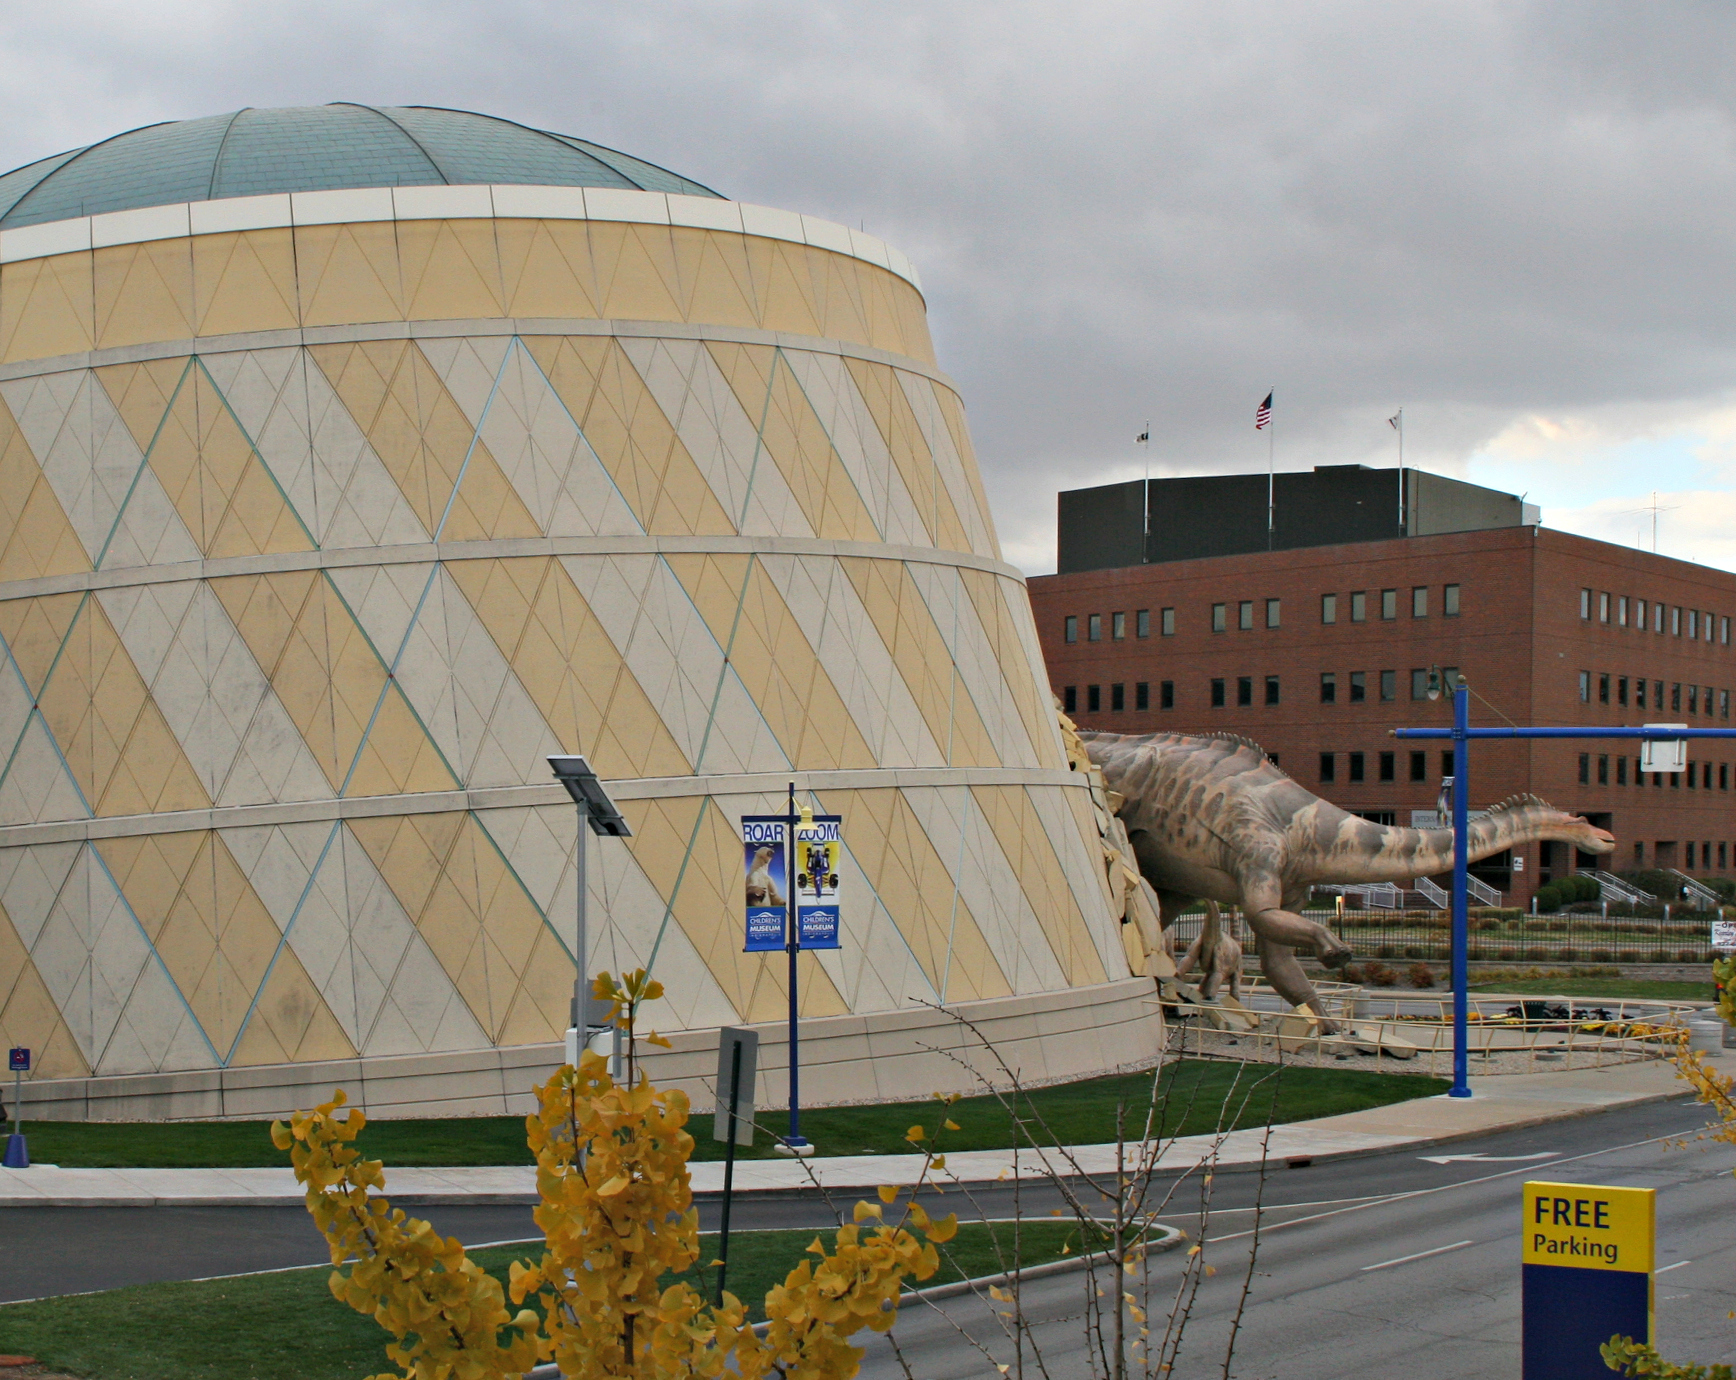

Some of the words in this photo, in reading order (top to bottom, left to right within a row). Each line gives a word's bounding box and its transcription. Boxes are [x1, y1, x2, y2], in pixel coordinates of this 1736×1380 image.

[744, 824, 784, 841] ROAR
[798, 824, 838, 840] ZOOM
[1535, 1196, 1610, 1229] FREE
[1534, 1234, 1618, 1264] Parking
